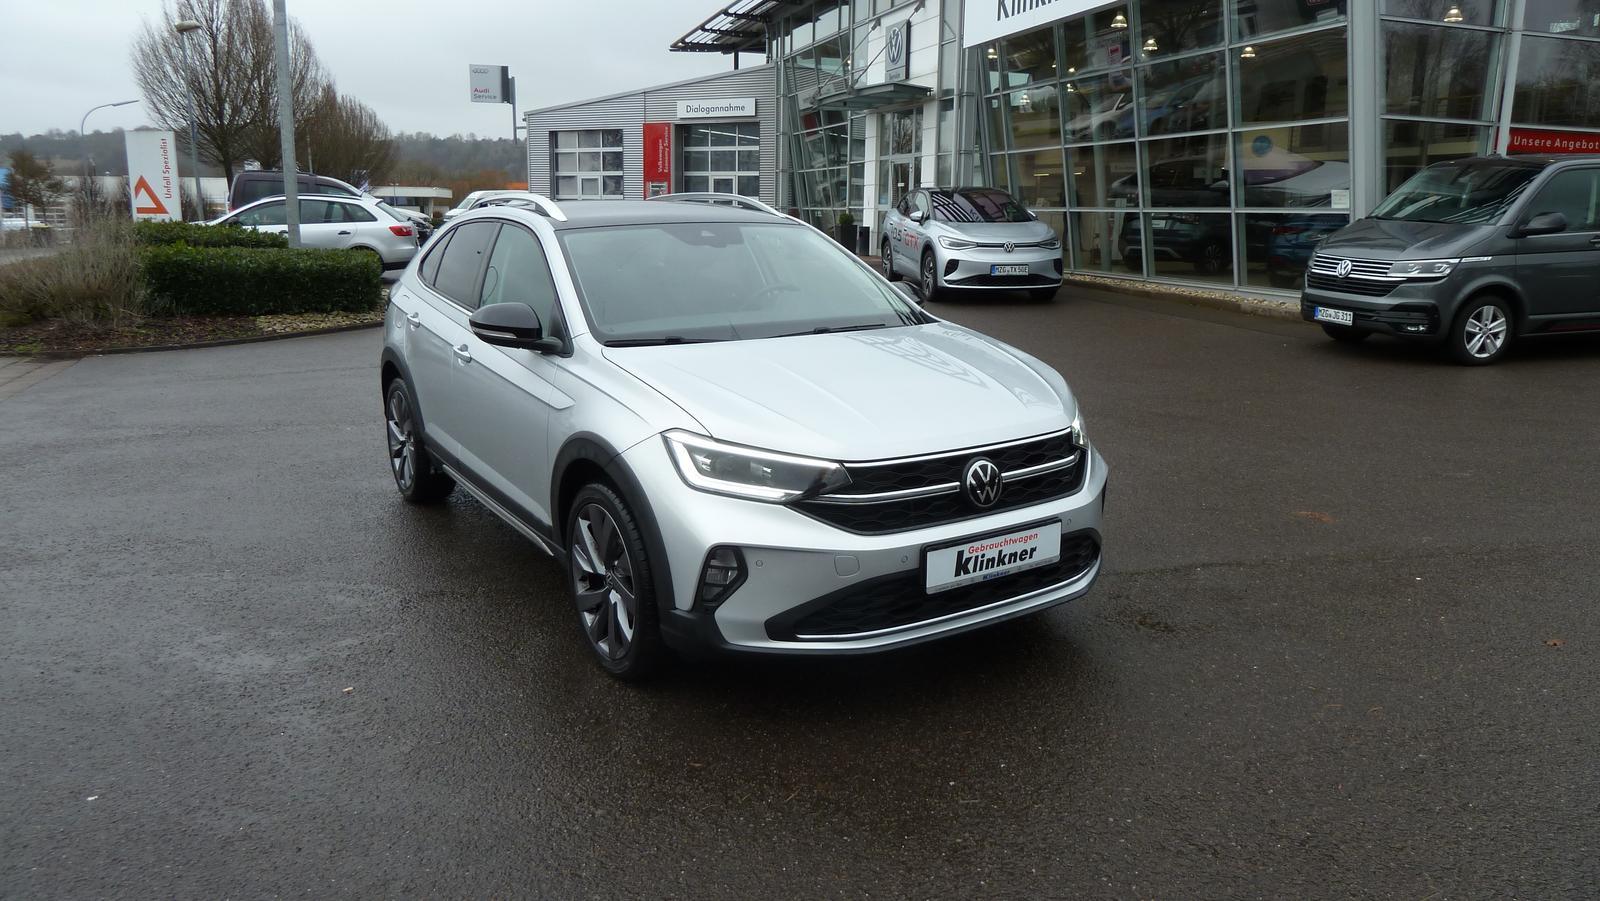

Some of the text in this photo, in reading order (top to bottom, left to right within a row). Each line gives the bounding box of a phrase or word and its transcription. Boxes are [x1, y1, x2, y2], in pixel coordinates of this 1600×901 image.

[686, 103, 746, 115] Dialogannahme
[1513, 135, 1552, 148] Unsere
[160, 138, 172, 199] Unfall Spezialist
[968, 532, 1038, 555] Gebrauchtwagen
